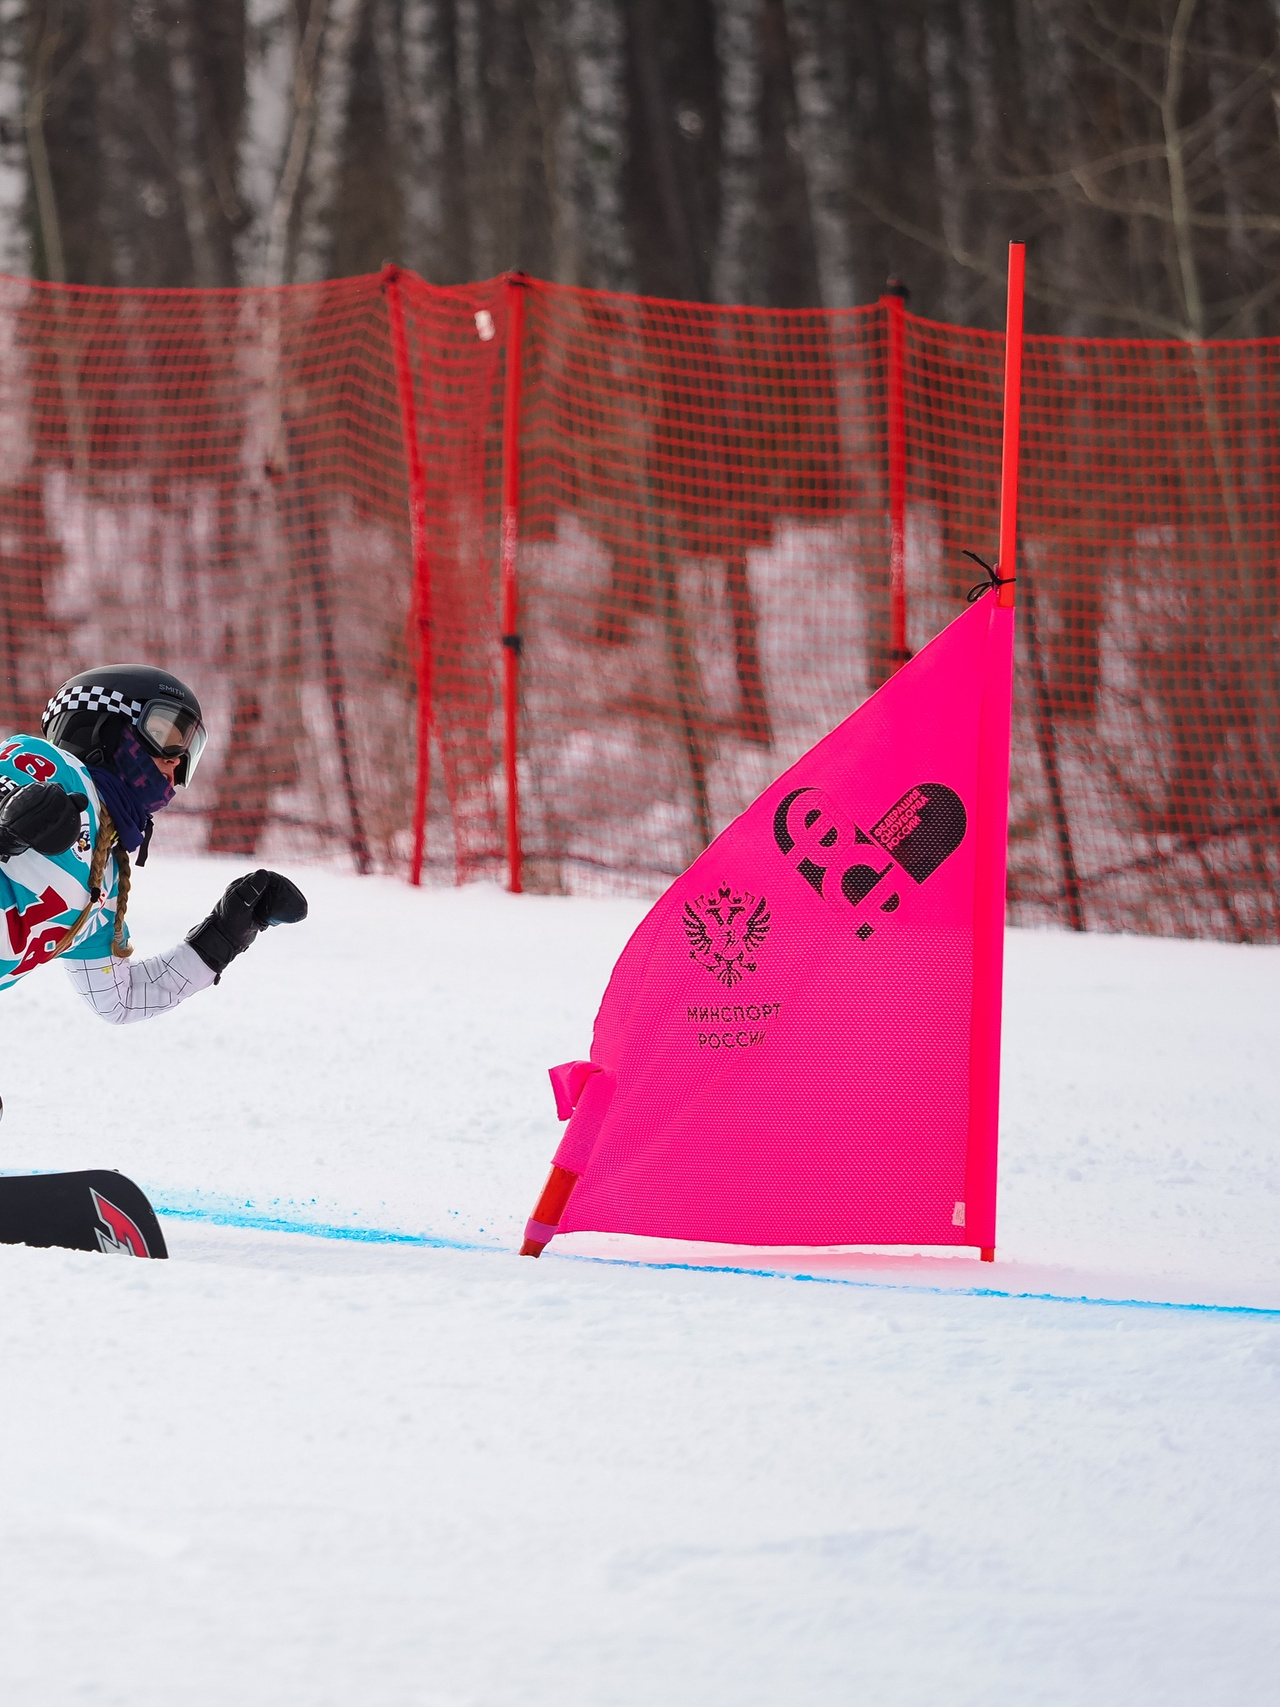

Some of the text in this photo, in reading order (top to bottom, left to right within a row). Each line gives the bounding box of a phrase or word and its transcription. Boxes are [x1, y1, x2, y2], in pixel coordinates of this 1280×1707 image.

[159, 683, 185, 698] SMITH
[874, 789, 921, 837] ФЕДЕРАЦИЯ
[880, 795, 930, 844] СНОУБОРДА
[886, 815, 923, 851] РОССИИ
[4, 884, 75, 977] 18
[686, 1002, 782, 1023] МИНСПОРТ
